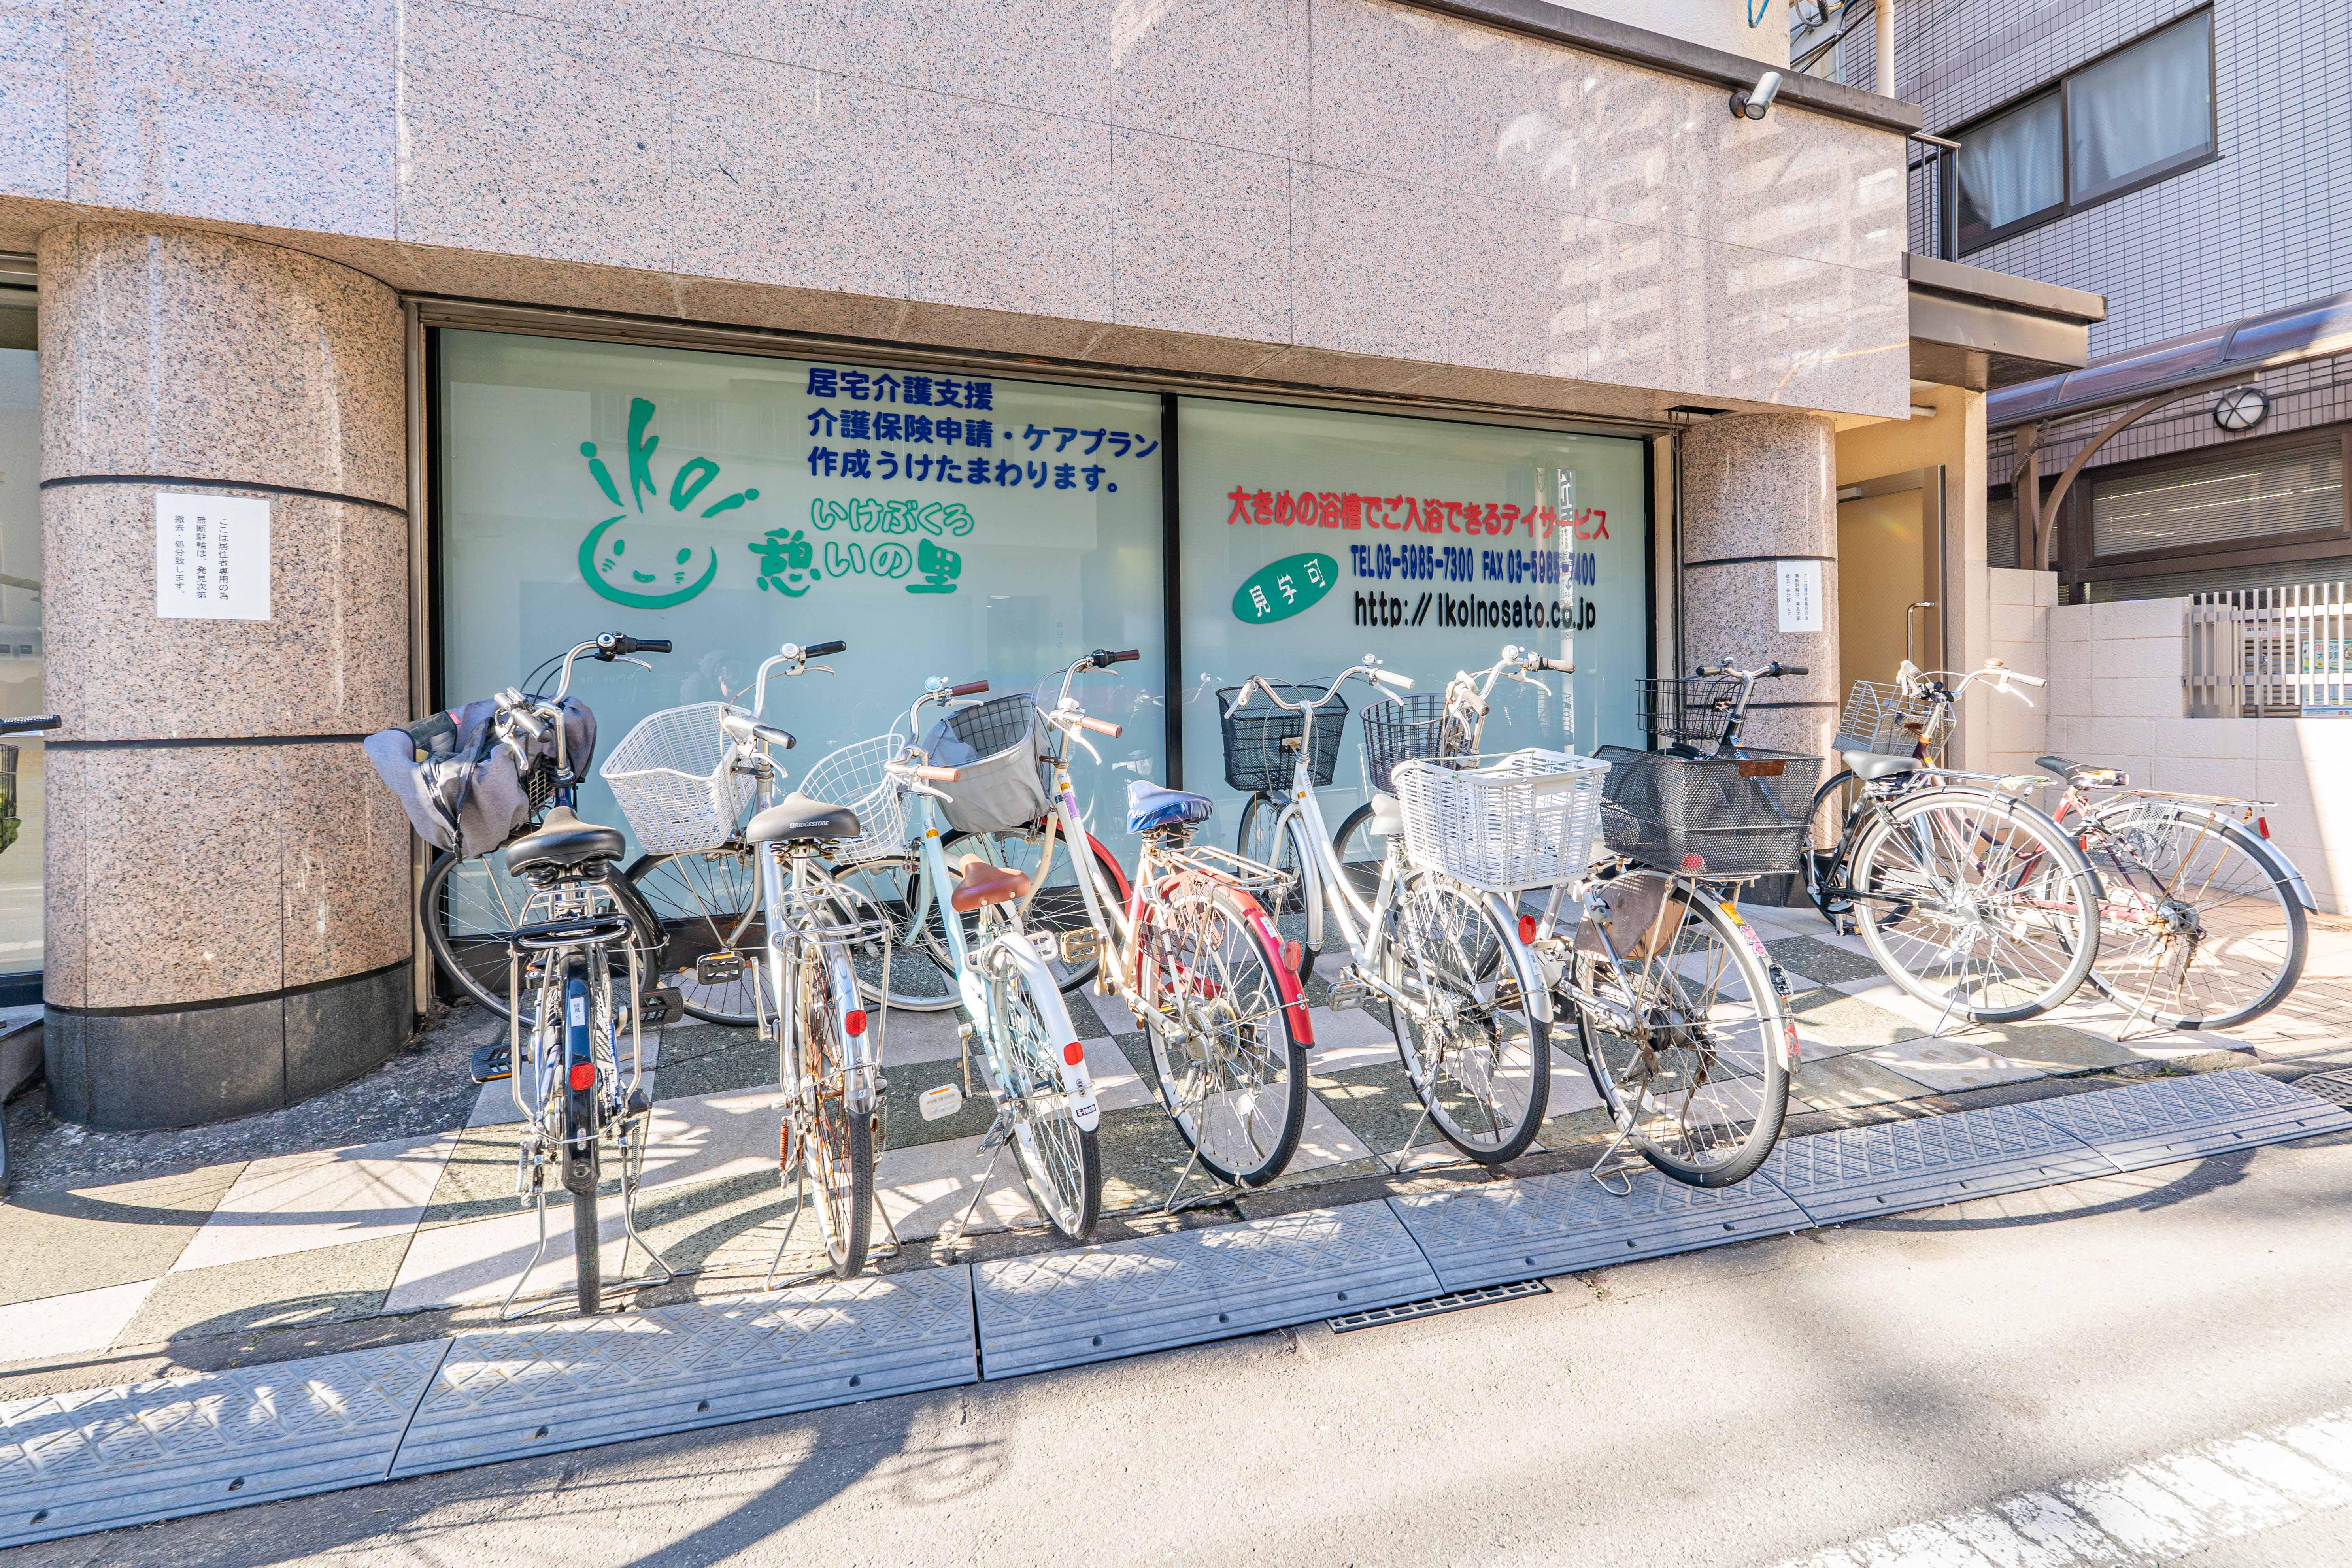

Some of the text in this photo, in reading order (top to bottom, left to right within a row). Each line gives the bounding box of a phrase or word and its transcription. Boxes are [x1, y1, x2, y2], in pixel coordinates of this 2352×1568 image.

[807, 368, 993, 411] 居宅介護支援
[807, 446, 1118, 493] 作成うけたまわります。
[811, 498, 975, 537] いけぶくろ
[1228, 485, 1610, 540] 大きめの浴槽でご入浴できるデイサービス
[218, 518, 229, 600] ここは居住者専用の為
[748, 527, 962, 598] 憩いの里
[1482, 549, 1504, 581] FAX
[789, 821, 830, 829] BRIDGESTONE
